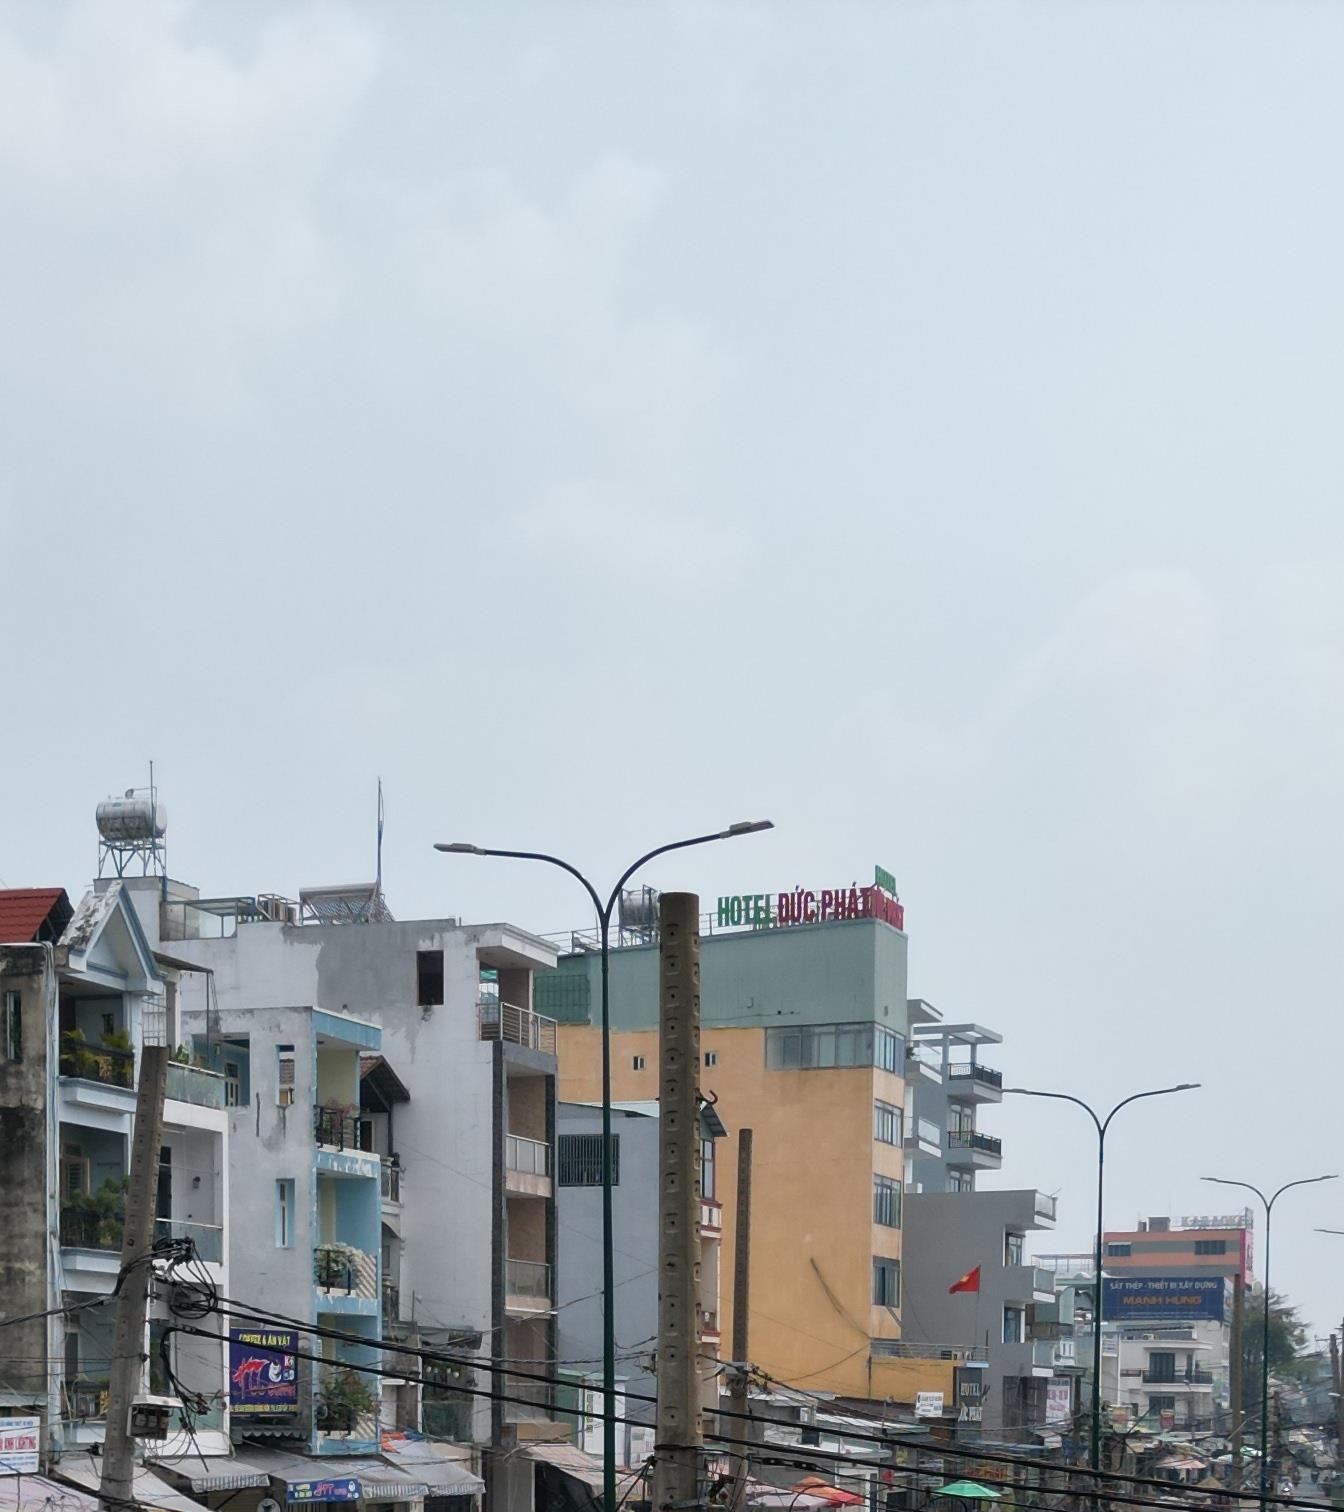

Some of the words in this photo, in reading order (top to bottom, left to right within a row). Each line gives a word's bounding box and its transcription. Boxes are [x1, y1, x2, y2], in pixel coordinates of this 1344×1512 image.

[717, 894, 775, 927] HOTEL
[778, 885, 816, 923] ĐỨC
[821, 881, 870, 920] PHÁT
